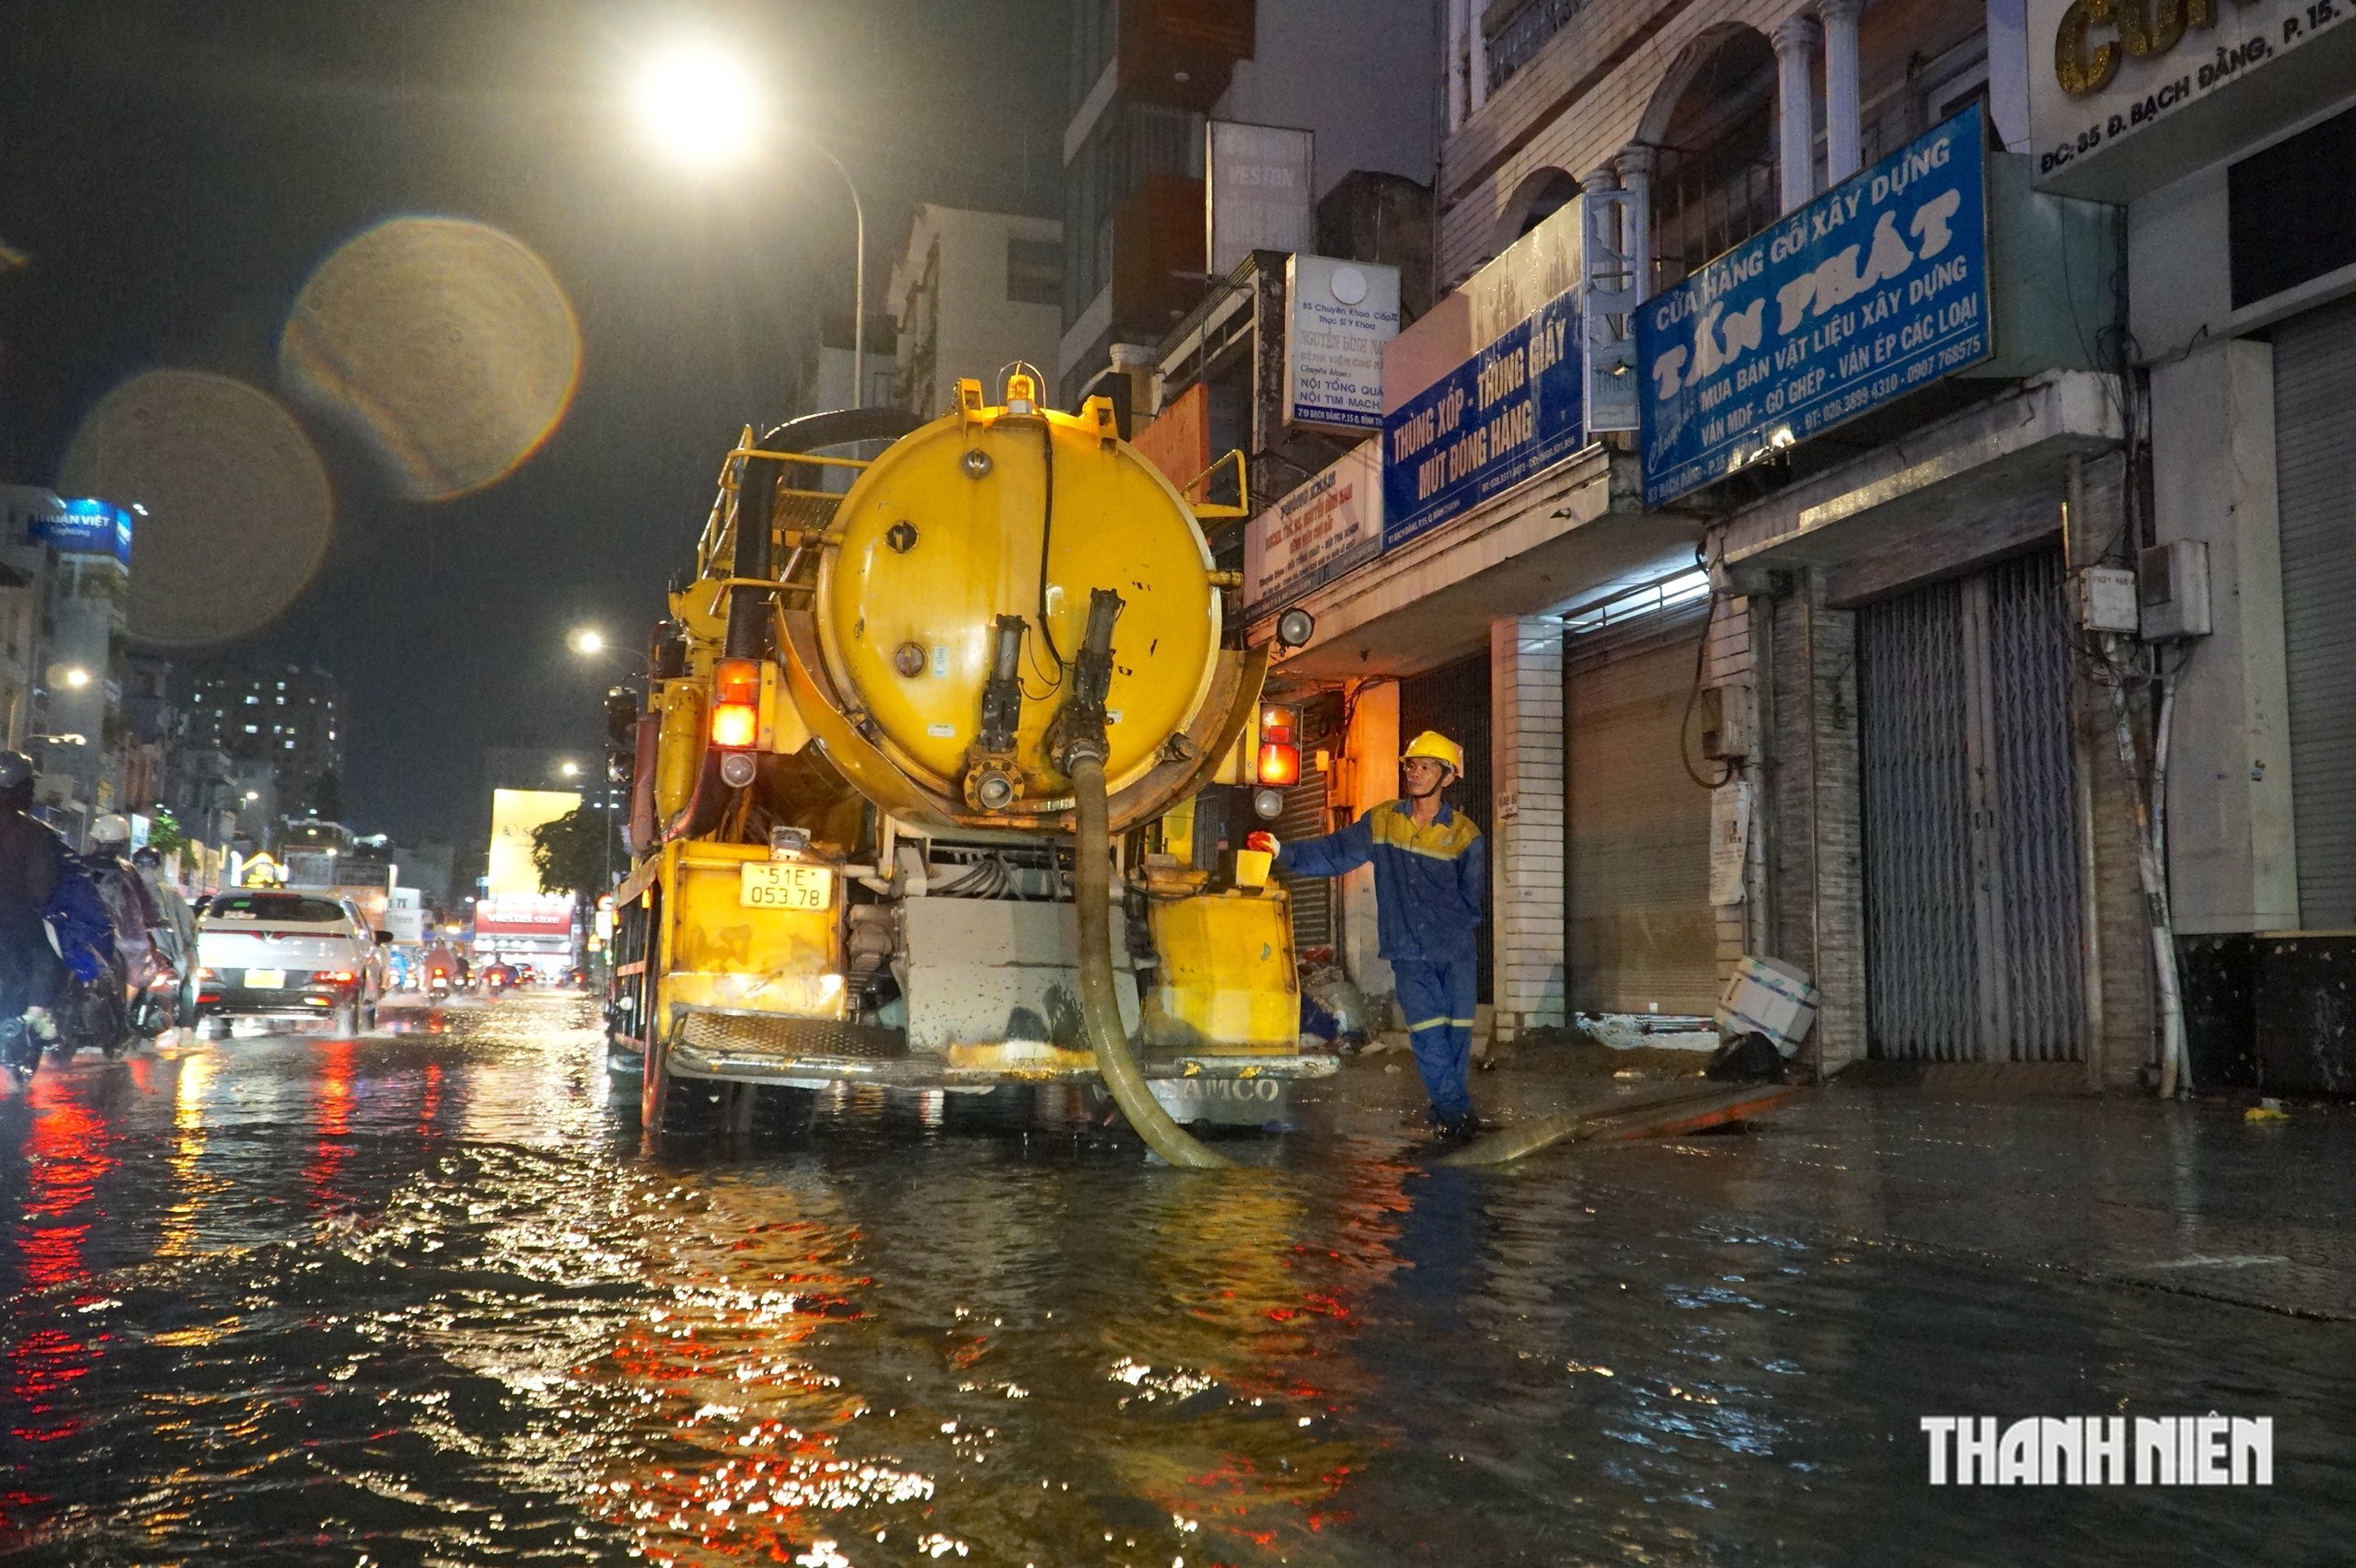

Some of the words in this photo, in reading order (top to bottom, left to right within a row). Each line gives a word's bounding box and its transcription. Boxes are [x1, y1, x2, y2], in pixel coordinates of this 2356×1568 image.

[2131, 75, 2190, 124] BẠCH
[1657, 290, 1698, 332] CỬA
[1702, 247, 1764, 305] HÀNG
[1770, 213, 1806, 264] GỖ
[1812, 189, 1863, 243] XÂY
[1871, 137, 1951, 205] DỰNG
[1302, 302, 1312, 311] BS
[1314, 304, 1346, 319] Chuyên
[1348, 306, 1370, 318] Khoa
[1319, 315, 1337, 326] Thạc
[1348, 319, 1354, 328] Y
[1355, 319, 1376, 330] Khoa
[1701, 377, 1732, 412] MUA
[1737, 354, 1771, 393] BÁN
[1775, 336, 1808, 371] VẬT
[1813, 310, 1855, 352] LIỆU
[1861, 287, 1902, 330] XÂY
[1909, 255, 1968, 306] DỰNG
[1702, 415, 1725, 447] VÁN
[1727, 402, 1754, 434] MDF
[1766, 377, 1788, 415] GỖ
[1787, 364, 1826, 404] GHÉP
[1839, 343, 1870, 379] VÁN
[1874, 332, 1897, 363] ÉP
[1900, 313, 1934, 351] CÁC
[1938, 292, 1978, 333] LOẠI
[1300, 377, 1321, 391] NỘI
[1324, 376, 1357, 393] TỔNG
[1361, 383, 1384, 397] QUÁ
[1393, 407, 1435, 464] THÙNG
[1438, 378, 1465, 438] XỐP
[1477, 346, 1524, 411] THÙNG
[1529, 315, 1566, 379] GIẤY
[1299, 391, 1321, 406] NỘI
[1325, 394, 1344, 405] TIM
[1348, 398, 1380, 410] MẠCH
[1298, 408, 1309, 418] 79
[1418, 448, 1448, 501] MÚT
[1490, 399, 1533, 459] HÀNG
[80, 514, 111, 529] VIỆT
[768, 868, 805, 886] 51E
[751, 886, 820, 906] 053.78
